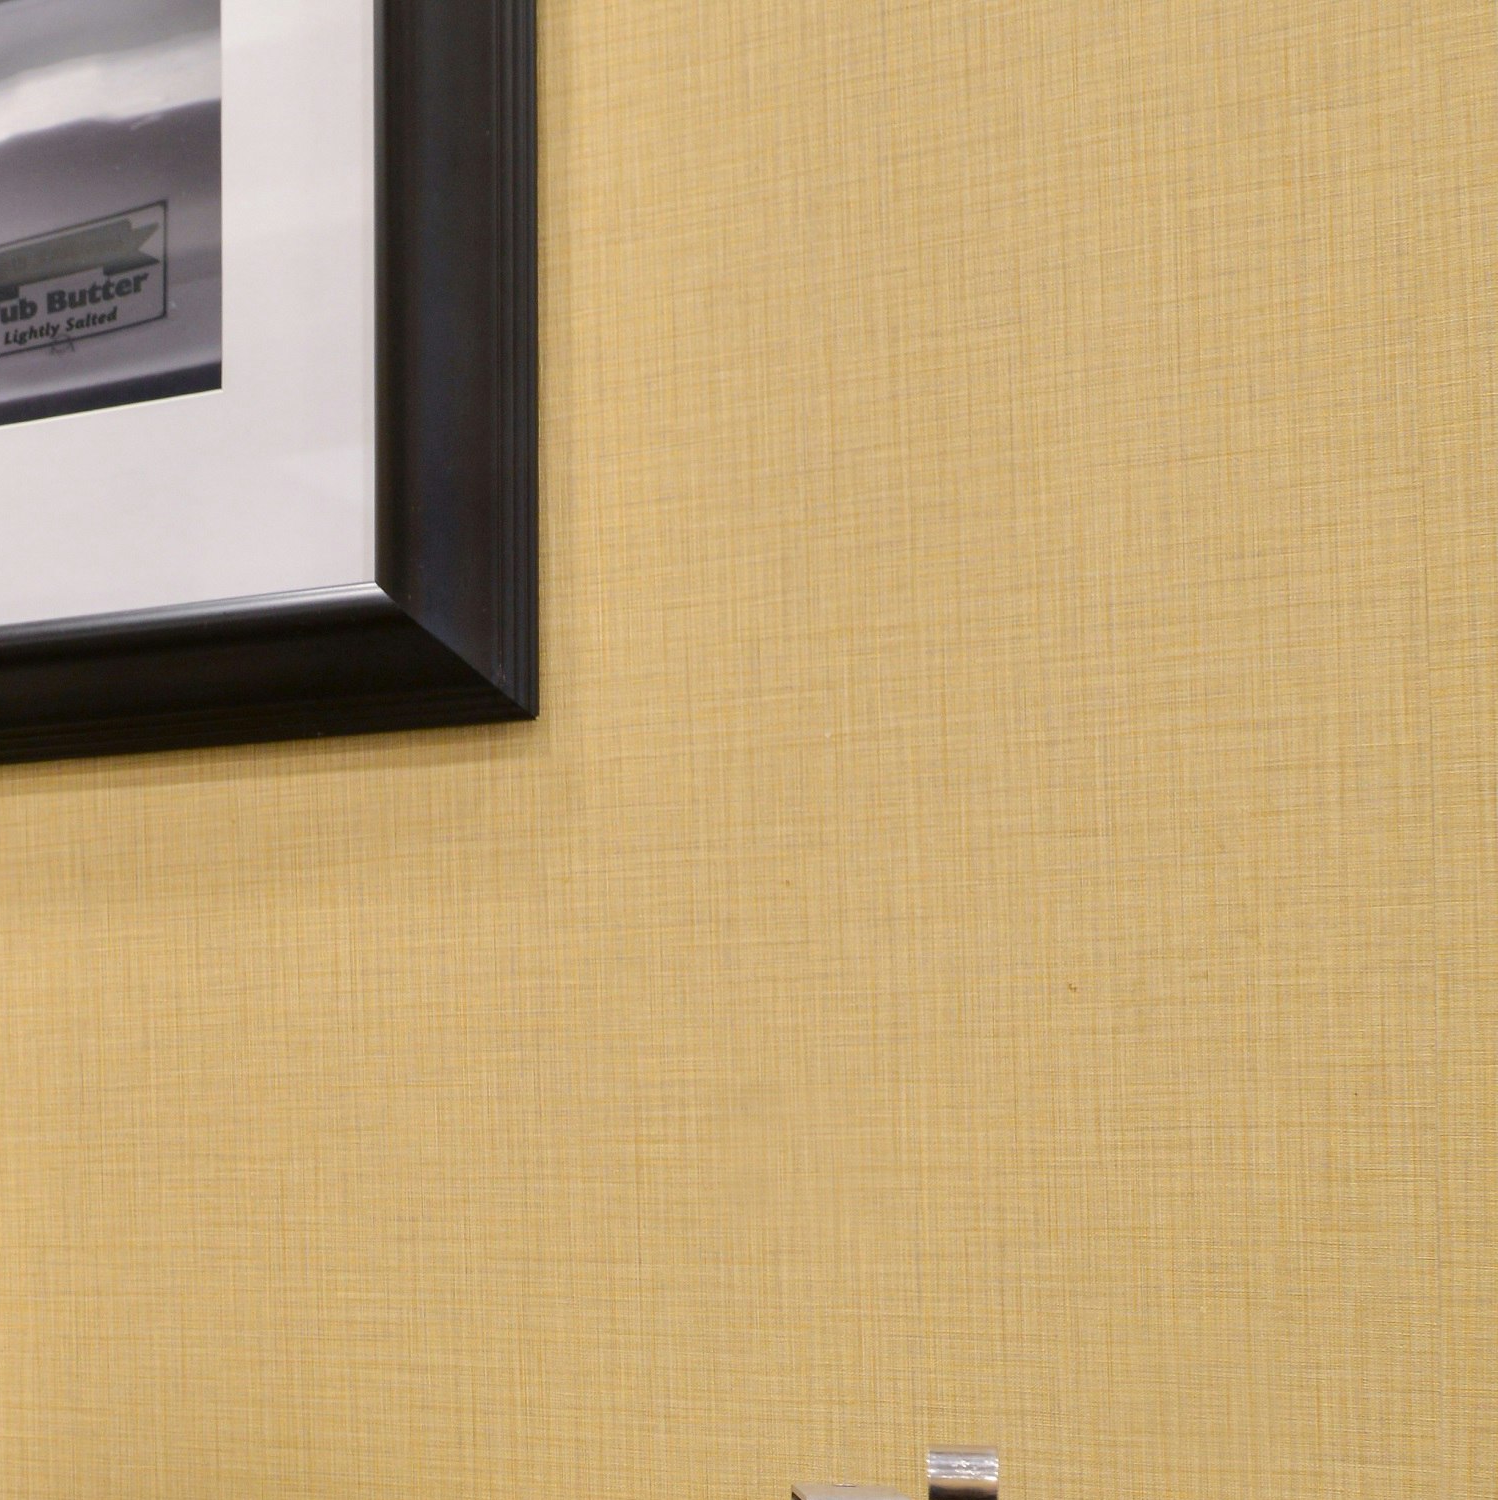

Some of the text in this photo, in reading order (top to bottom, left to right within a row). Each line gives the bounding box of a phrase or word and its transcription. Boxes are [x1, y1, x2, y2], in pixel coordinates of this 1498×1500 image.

[46, 272, 149, 315] Butter
[4, 306, 119, 345] Lightly Salted
